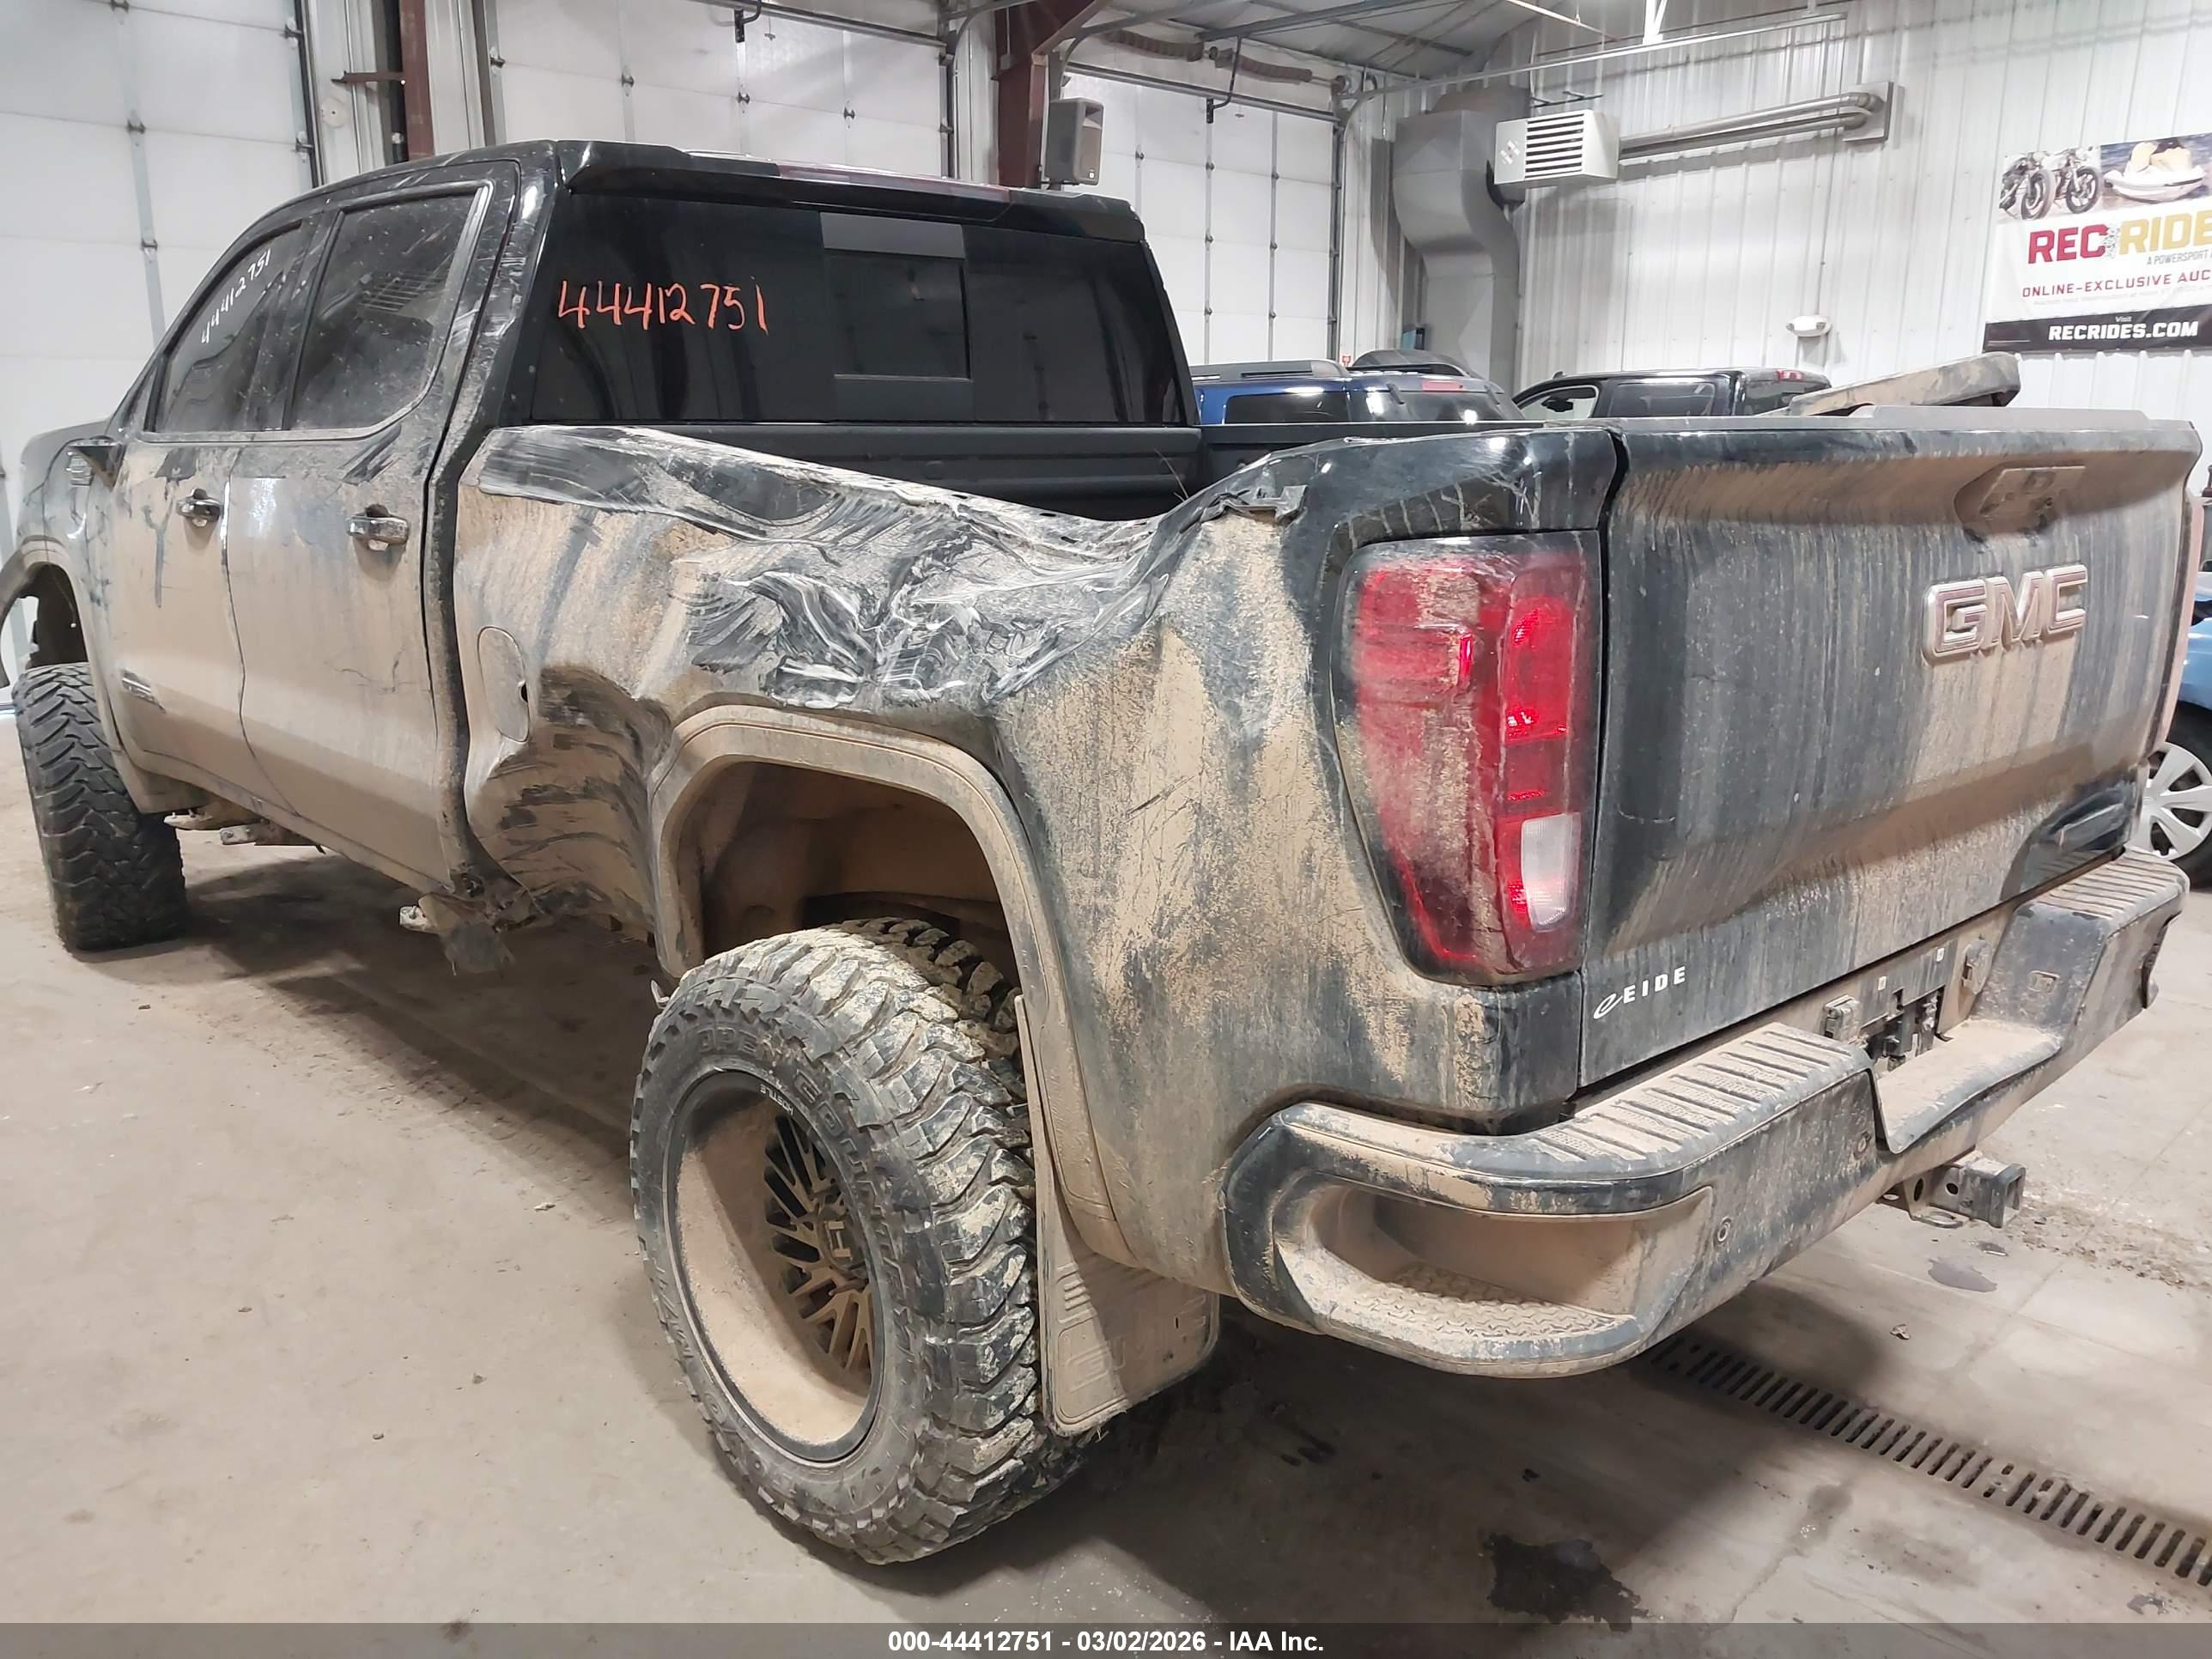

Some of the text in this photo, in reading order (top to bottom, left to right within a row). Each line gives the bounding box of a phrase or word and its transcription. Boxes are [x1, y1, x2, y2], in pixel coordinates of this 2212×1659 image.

[2028, 225, 2109, 264] REC
[2022, 273, 2172, 297] ONLINE-EXCLUSIVE
[558, 280, 769, 336] 44412751
[2048, 320, 2199, 341] RECRIDES.COM
[1924, 563, 2088, 659] GMC
